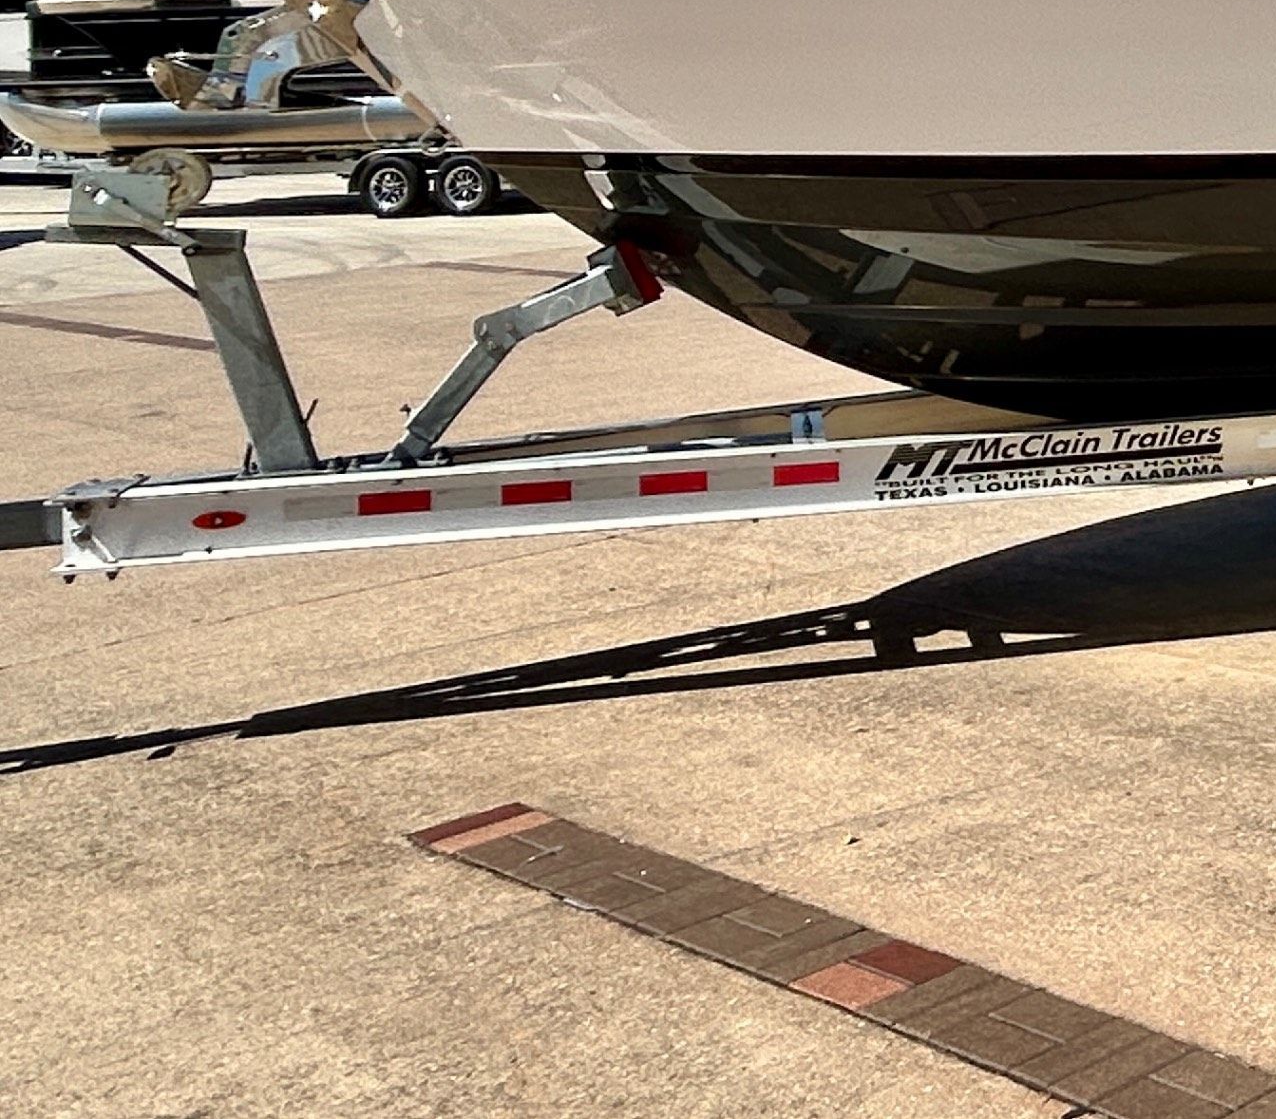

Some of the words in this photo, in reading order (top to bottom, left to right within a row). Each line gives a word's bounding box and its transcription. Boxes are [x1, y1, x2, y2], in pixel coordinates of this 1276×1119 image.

[967, 431, 1101, 462] McClain
[1111, 424, 1223, 451] Trailers
[874, 486, 948, 501] TEXAS
[974, 474, 1096, 494] LOUISIANA
[1120, 463, 1224, 483] ALABAMA
[954, 472, 999, 483] FOR
[1007, 469, 1046, 479] THE
[1056, 462, 1134, 475] LONG
